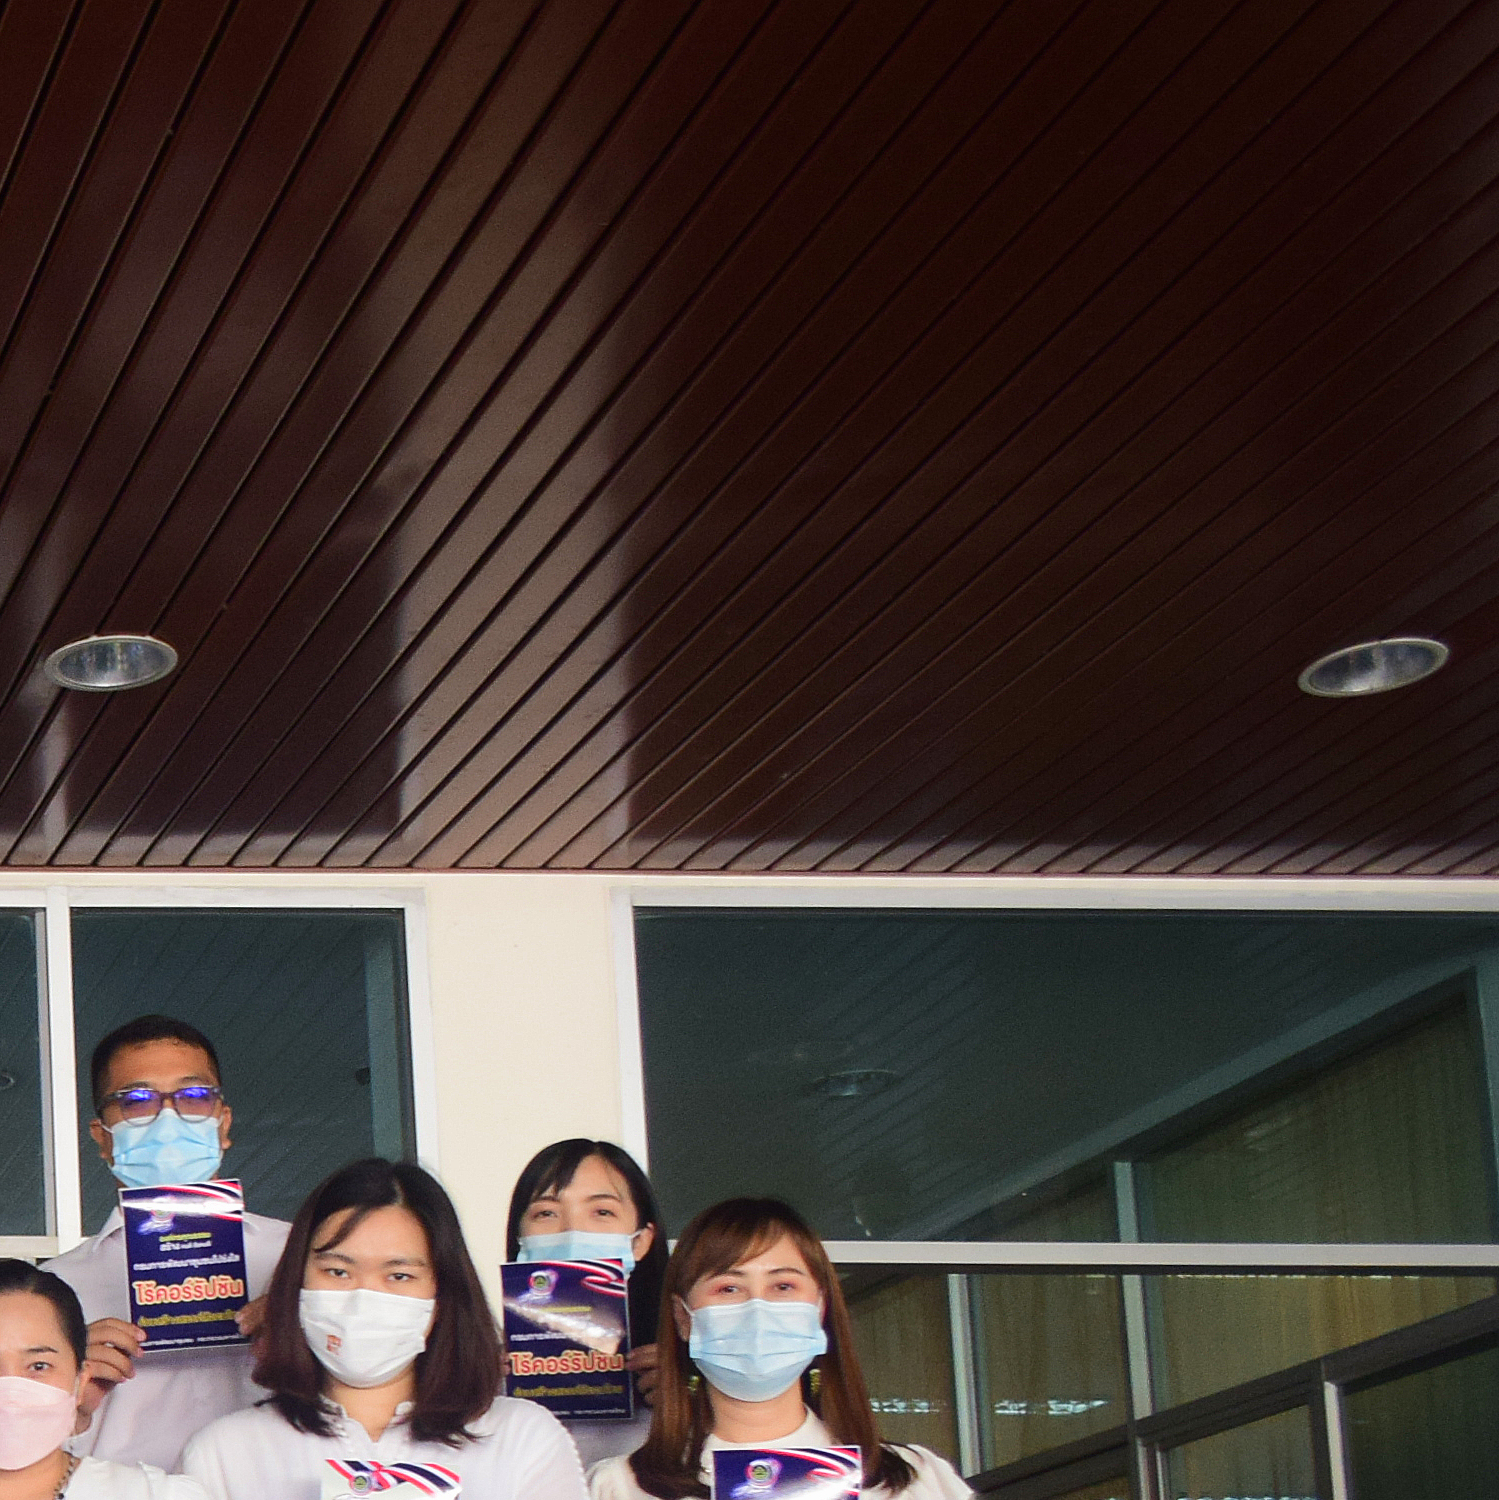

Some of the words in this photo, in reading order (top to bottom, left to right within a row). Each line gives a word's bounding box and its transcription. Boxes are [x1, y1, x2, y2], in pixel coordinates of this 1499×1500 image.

[133, 1274, 244, 1305] ไร้คอร์รัปชัน
[510, 1350, 625, 1375] ไร้คอร์รัปชัน
